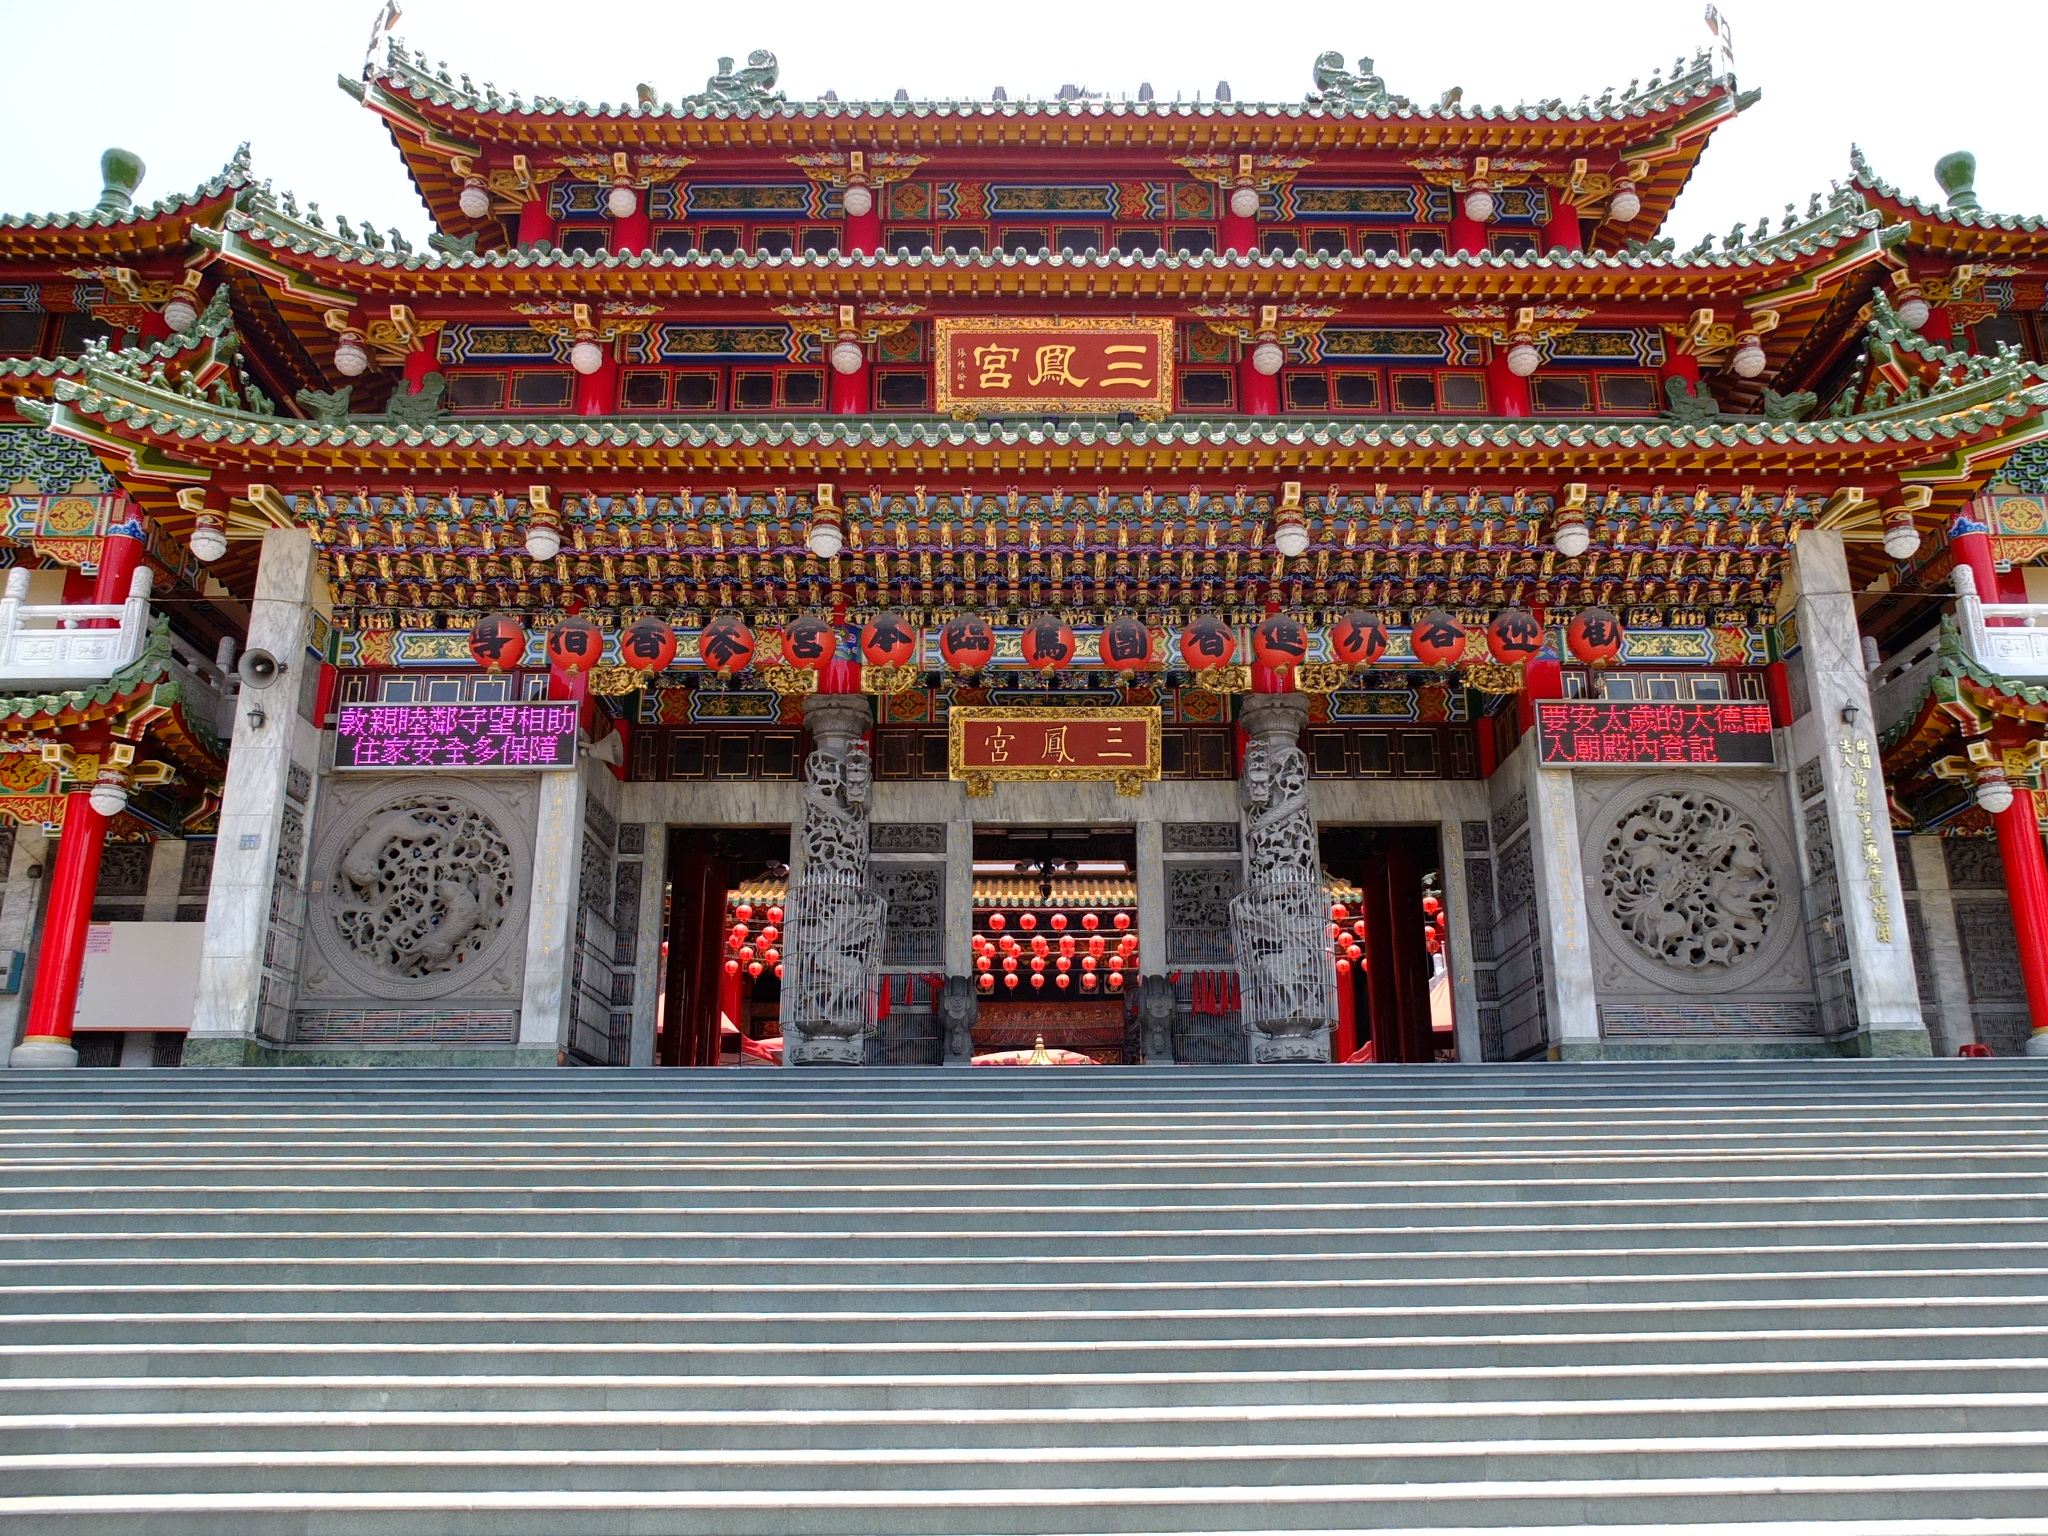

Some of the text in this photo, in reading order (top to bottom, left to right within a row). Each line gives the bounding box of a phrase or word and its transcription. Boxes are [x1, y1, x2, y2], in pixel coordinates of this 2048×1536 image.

[973, 342, 1152, 389] 三鳳宮
[550, 619, 590, 656] 指
[625, 619, 667, 660] 香
[705, 617, 752, 666] 參
[786, 617, 829, 659] 宮
[867, 615, 913, 653] 本
[945, 617, 990, 654] 臨
[1109, 619, 1147, 660] 團
[1188, 616, 1231, 656] 香
[1262, 616, 1305, 656] 進
[1342, 613, 1387, 658] 界
[1420, 614, 1466, 648] 各
[1496, 613, 1544, 653] 迎
[338, 705, 576, 736] 敦親睦鄰守望相助
[1540, 704, 1771, 734] 要安太歲的大德請
[352, 735, 560, 766] 住家安全多保障
[984, 725, 1133, 763] 三鳳宮
[1544, 734, 1719, 762] 入廟殿內登記
